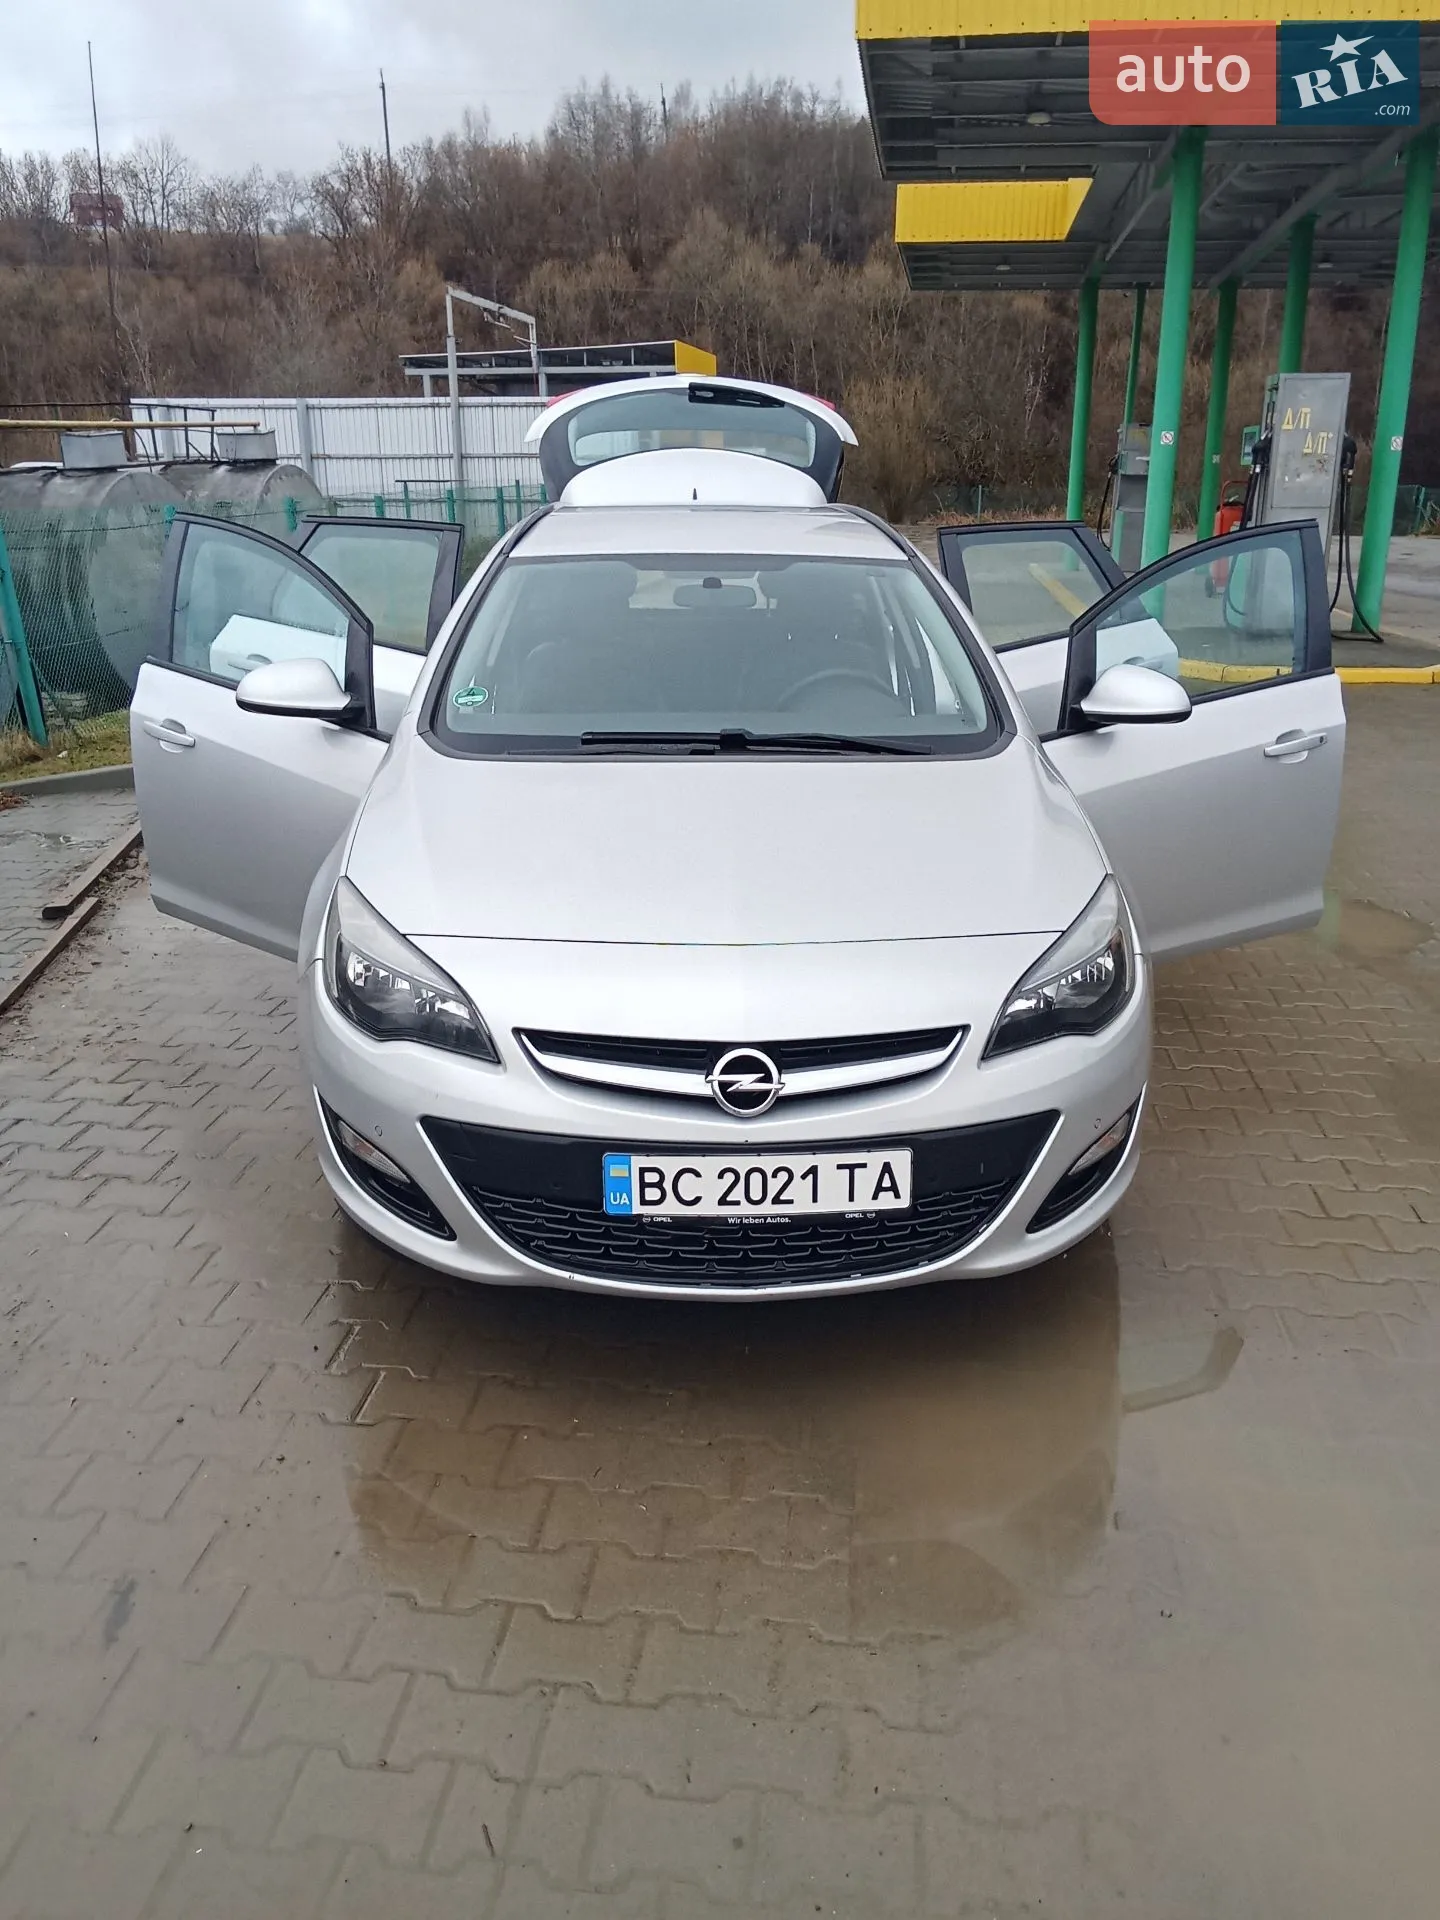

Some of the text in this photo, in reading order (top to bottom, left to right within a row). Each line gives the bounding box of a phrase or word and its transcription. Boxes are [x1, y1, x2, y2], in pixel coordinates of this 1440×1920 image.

[638, 1161, 902, 1207] BC 2021 TA
[610, 1192, 630, 1206] UA
[742, 1216, 765, 1224] leben
[766, 1216, 792, 1224] Autos.
